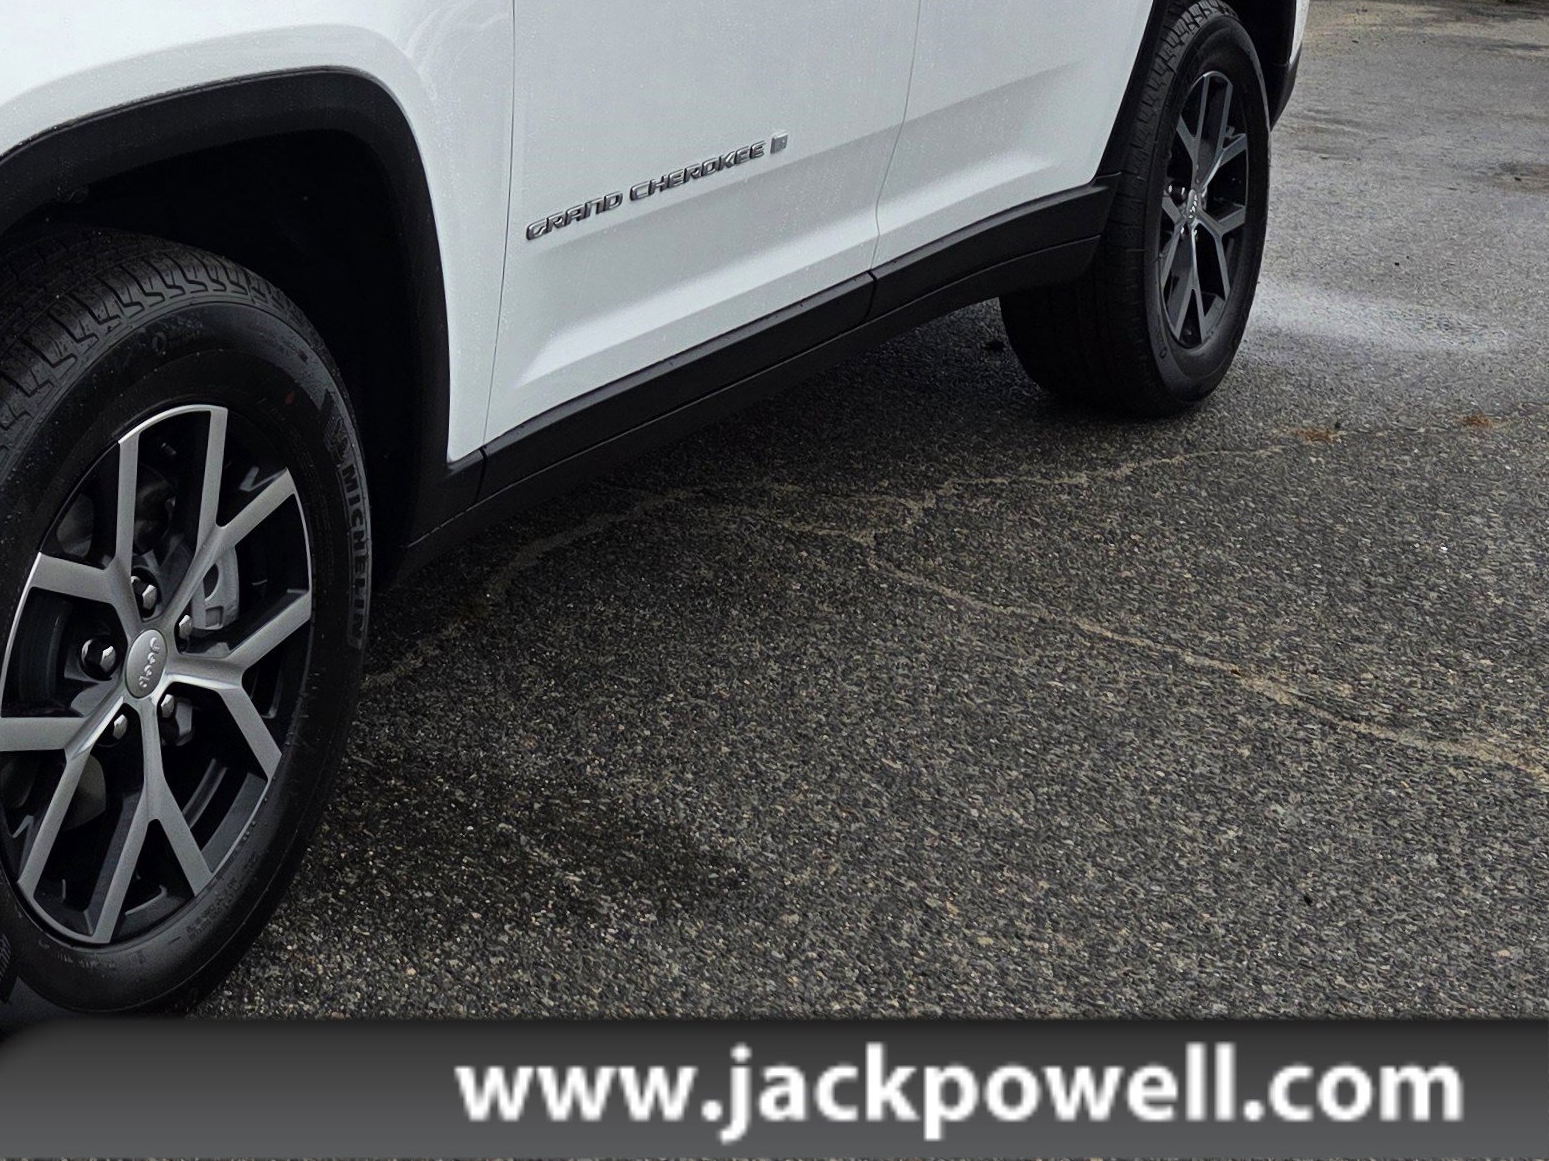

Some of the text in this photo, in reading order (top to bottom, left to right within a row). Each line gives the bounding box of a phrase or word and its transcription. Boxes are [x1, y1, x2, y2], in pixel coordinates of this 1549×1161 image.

[526, 191, 623, 241] GRAND
[630, 140, 767, 202] CHEROKEE
[340, 463, 369, 638] MICHELIN
